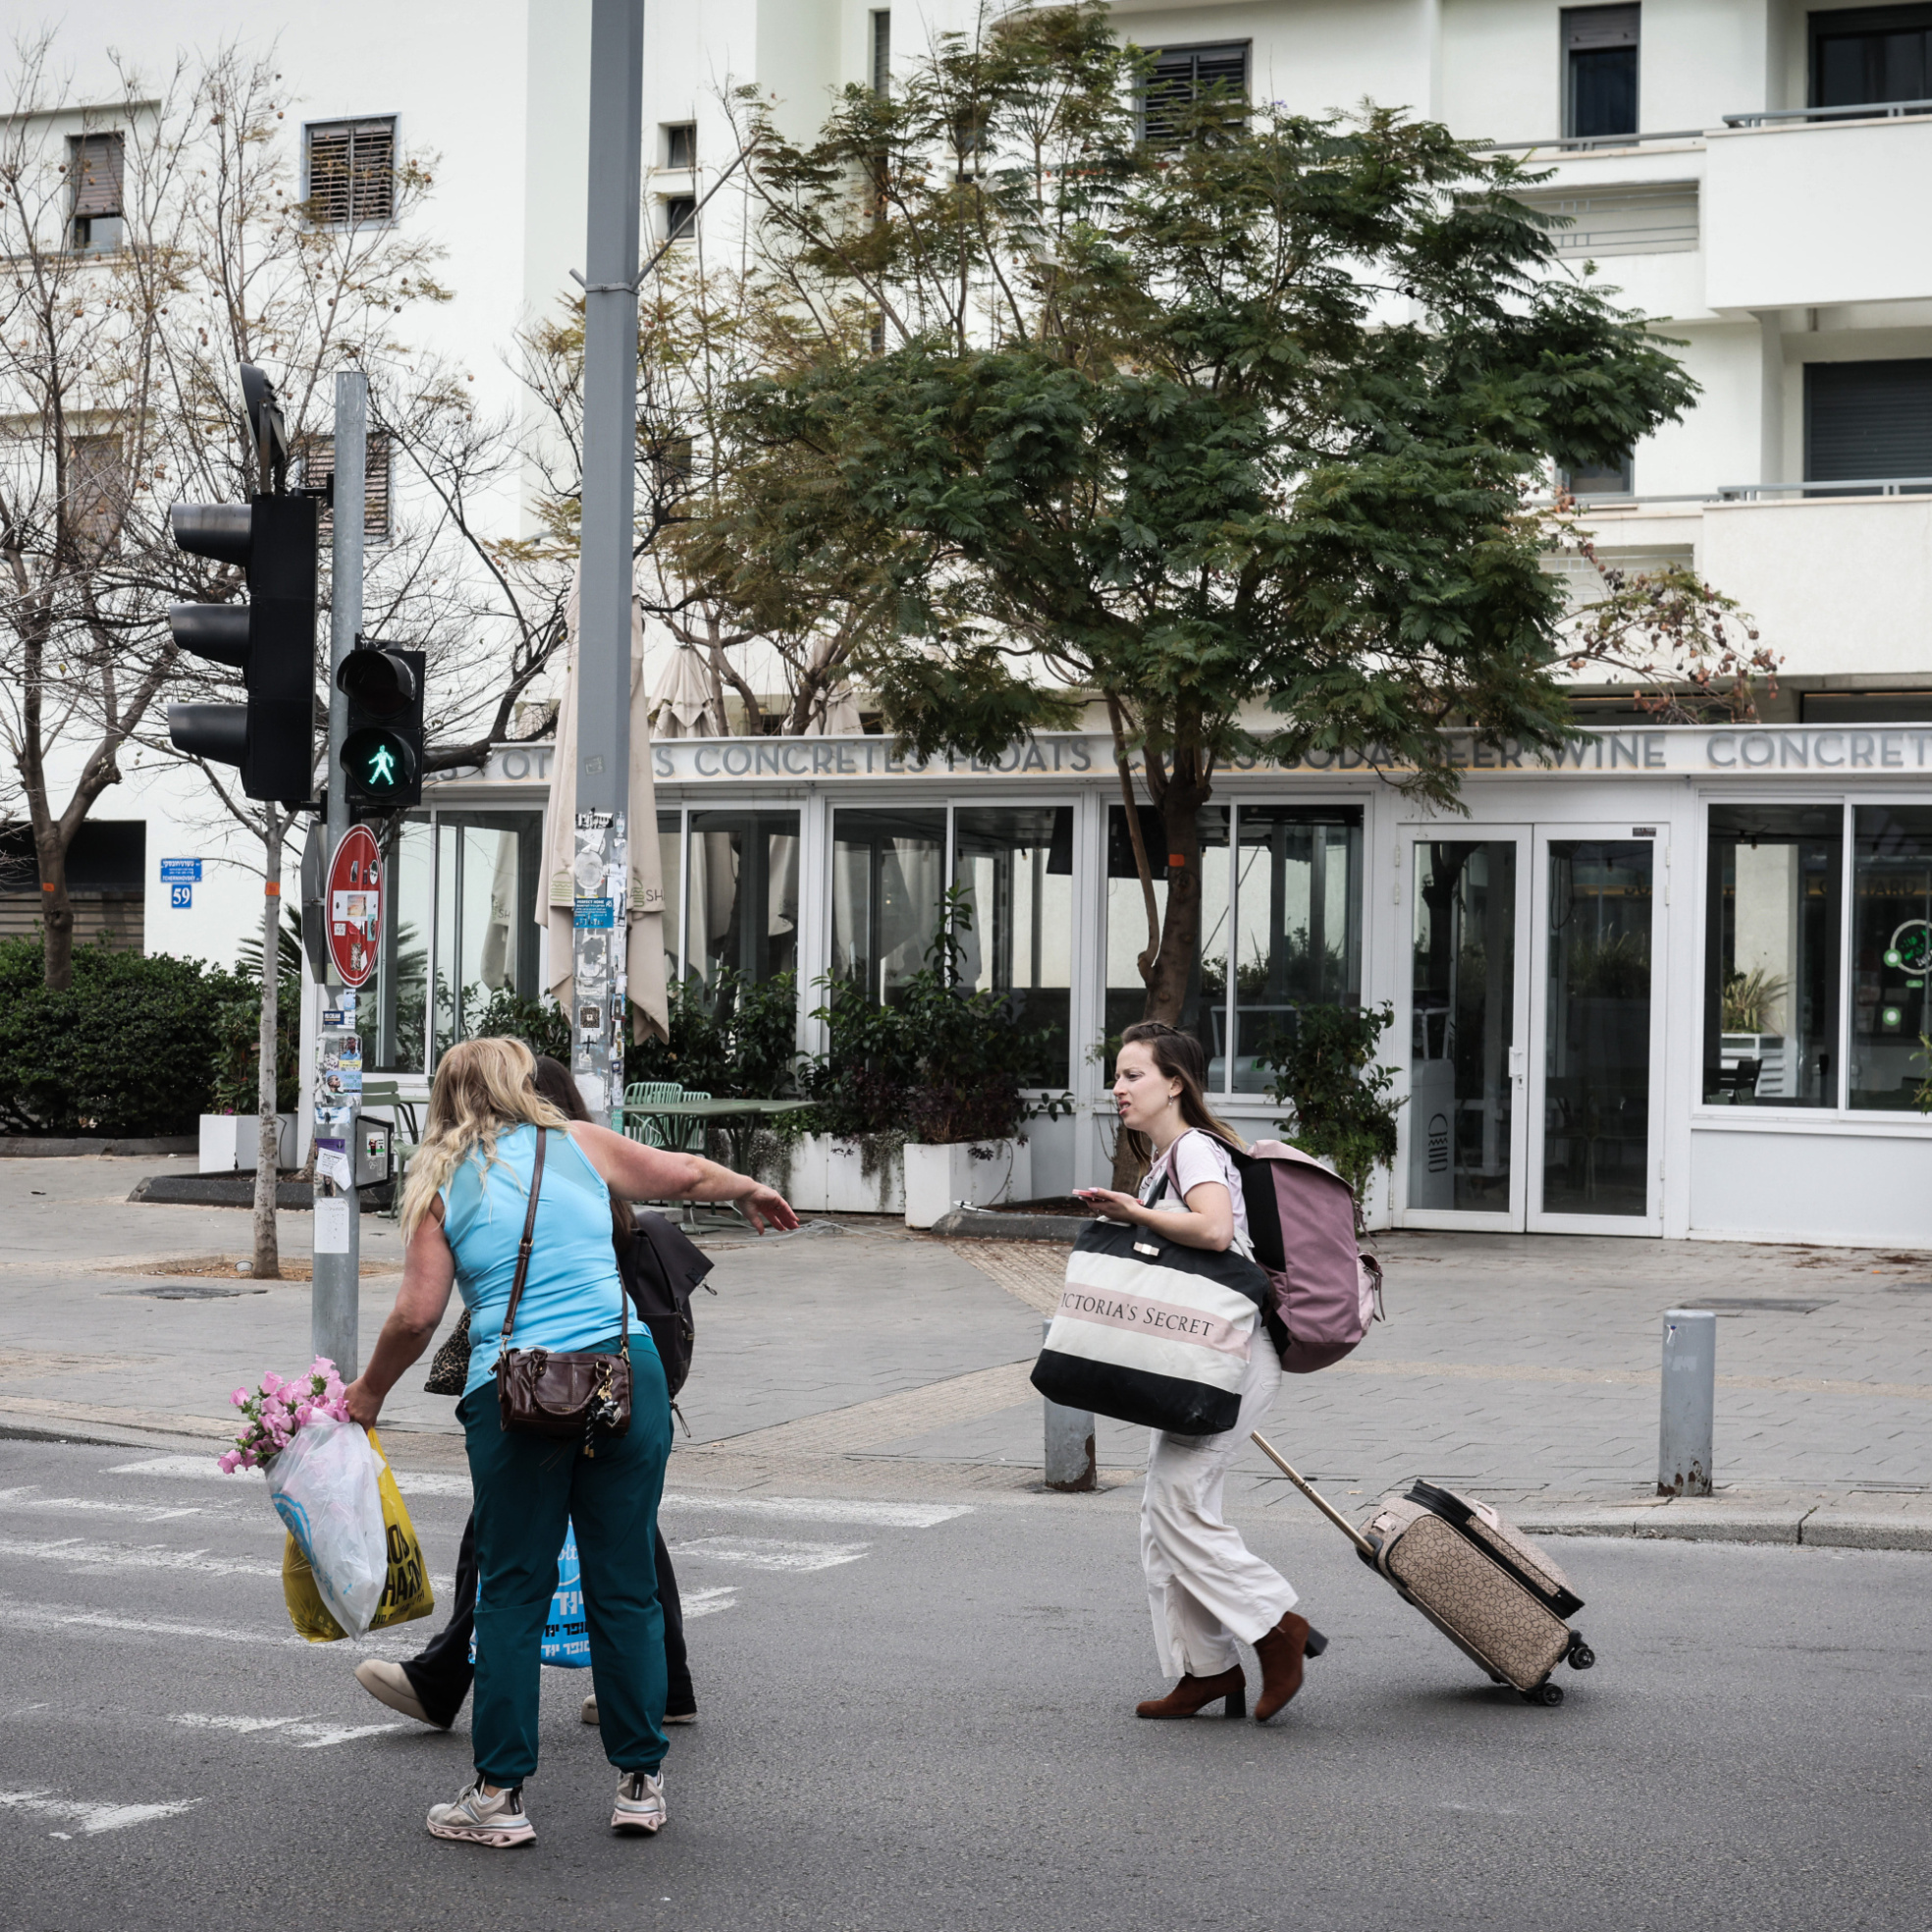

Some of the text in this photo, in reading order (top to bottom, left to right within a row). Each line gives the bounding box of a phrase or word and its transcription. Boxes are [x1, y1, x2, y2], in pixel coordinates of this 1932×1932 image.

[694, 741, 928, 777] CONCRETES
[1422, 733, 1523, 769] EER
[1551, 733, 1667, 769] WINE
[1706, 730, 1932, 768] CONCRET
[172, 886, 191, 905] 59
[1060, 1292, 1214, 1336] ICTORIA'S SECRET
